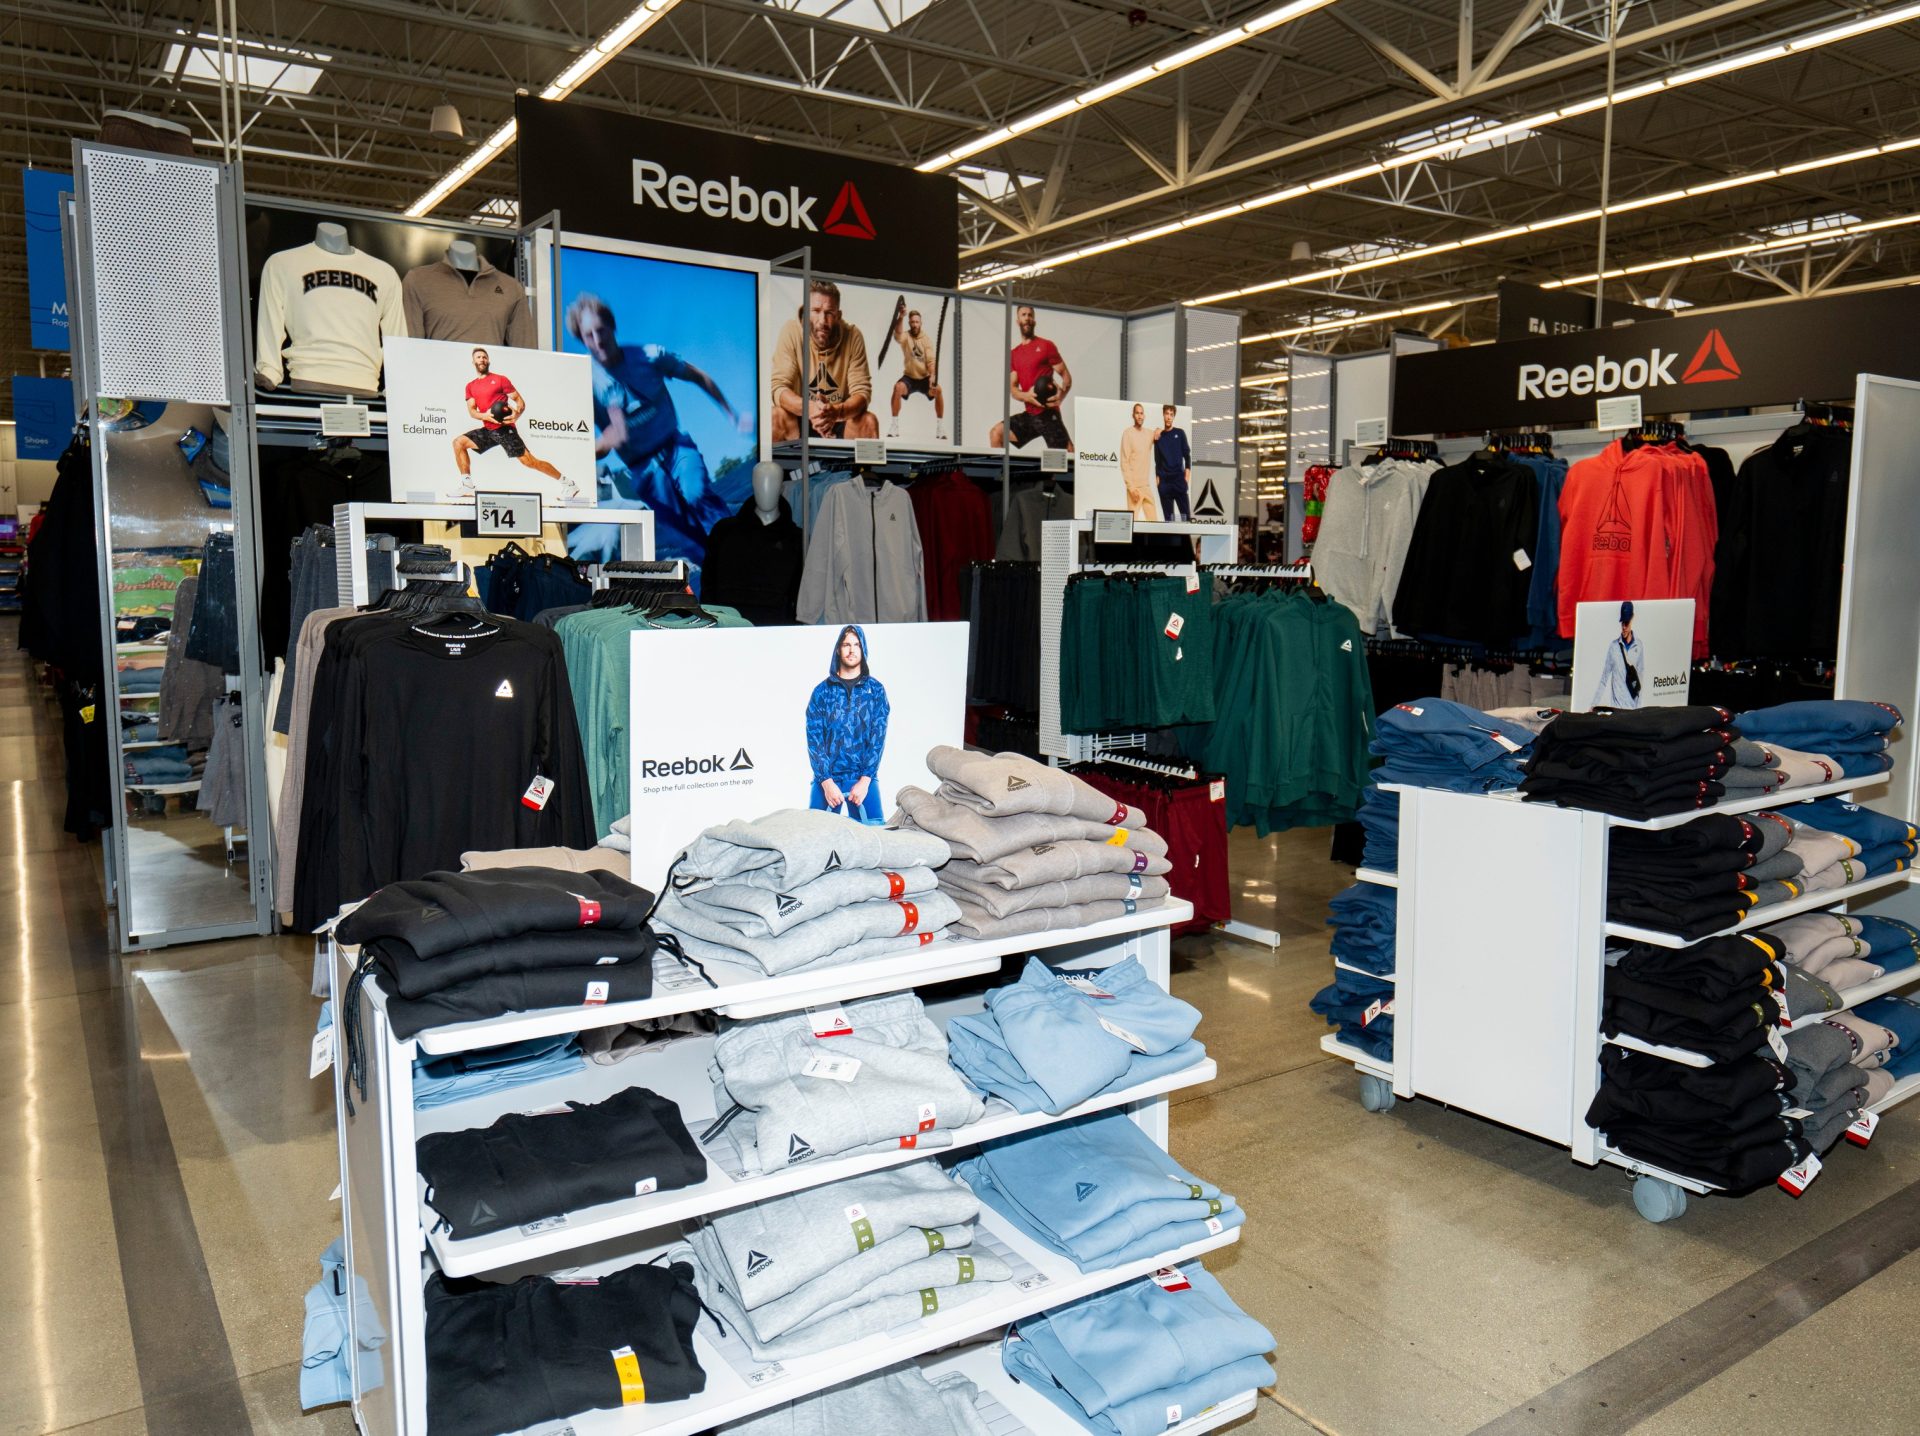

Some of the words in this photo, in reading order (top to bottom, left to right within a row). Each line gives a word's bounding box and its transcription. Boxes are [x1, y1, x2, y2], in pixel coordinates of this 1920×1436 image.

[632, 158, 819, 232] Reebok
[302, 270, 378, 304] REEBOK
[1518, 348, 1679, 401] Reebok
[419, 413, 447, 424] Julian
[529, 418, 574, 432] Reebok
[403, 424, 447, 435] Edelman
[1079, 451, 1108, 462] Reebok
[482, 508, 516, 528] $14
[1593, 534, 1632, 552] Reebo
[1653, 675, 1679, 688] Reebok
[642, 754, 725, 778] Reebok
[643, 786, 660, 794] Shop
[674, 783, 685, 791] full
[687, 781, 718, 790] collection
[742, 778, 754, 786] app
[778, 900, 804, 918] Reebok
[1056, 973, 1085, 981] ebok
[787, 1148, 816, 1164] Reebok
[1786, 1169, 1806, 1185] Reebok
[861, 1235, 870, 1243] EG
[747, 1258, 774, 1278] Reebok
